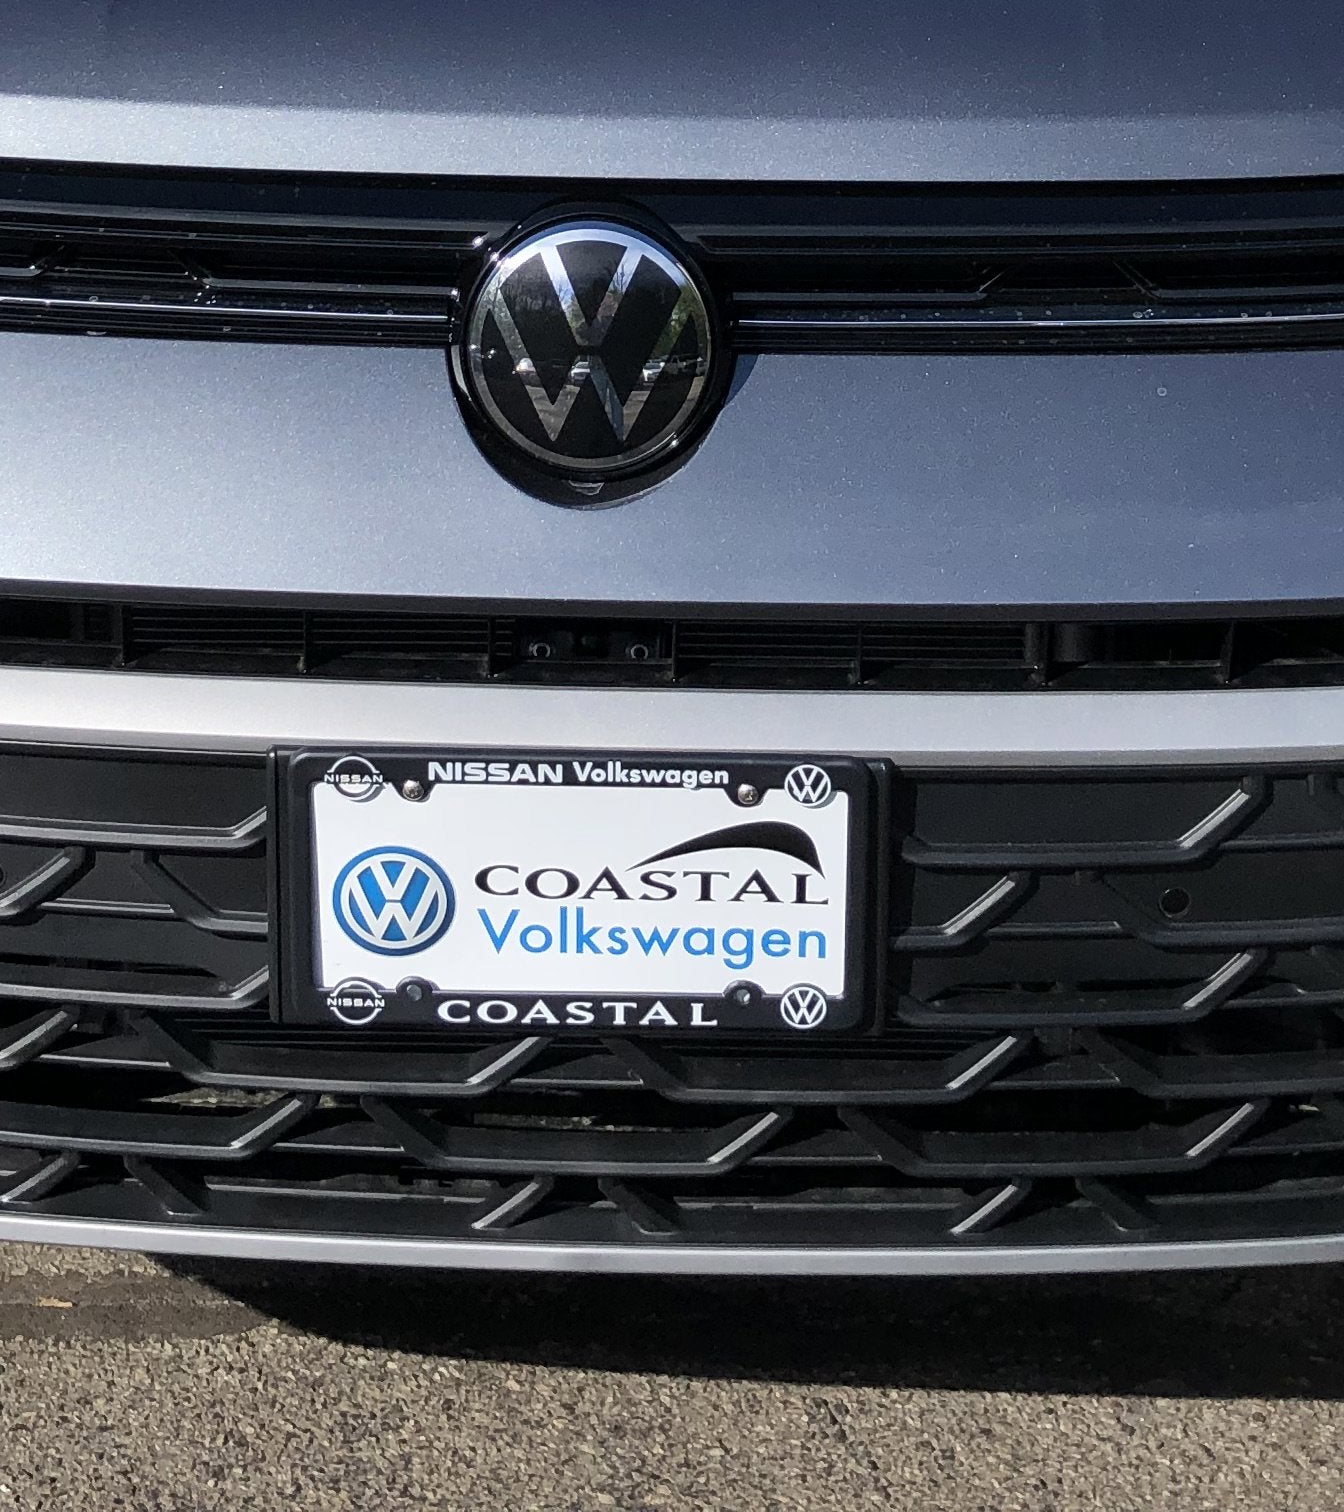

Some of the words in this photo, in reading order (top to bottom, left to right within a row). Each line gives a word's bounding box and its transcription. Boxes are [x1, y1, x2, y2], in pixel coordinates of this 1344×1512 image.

[324, 774, 383, 783] NISSAN
[427, 761, 564, 785] NISSAN
[573, 760, 730, 790] Volkswagen
[474, 864, 830, 906] COASTAL
[477, 906, 828, 971] Volkswagen
[327, 997, 385, 1007] NISSAN
[437, 998, 719, 1027] COASTAL
